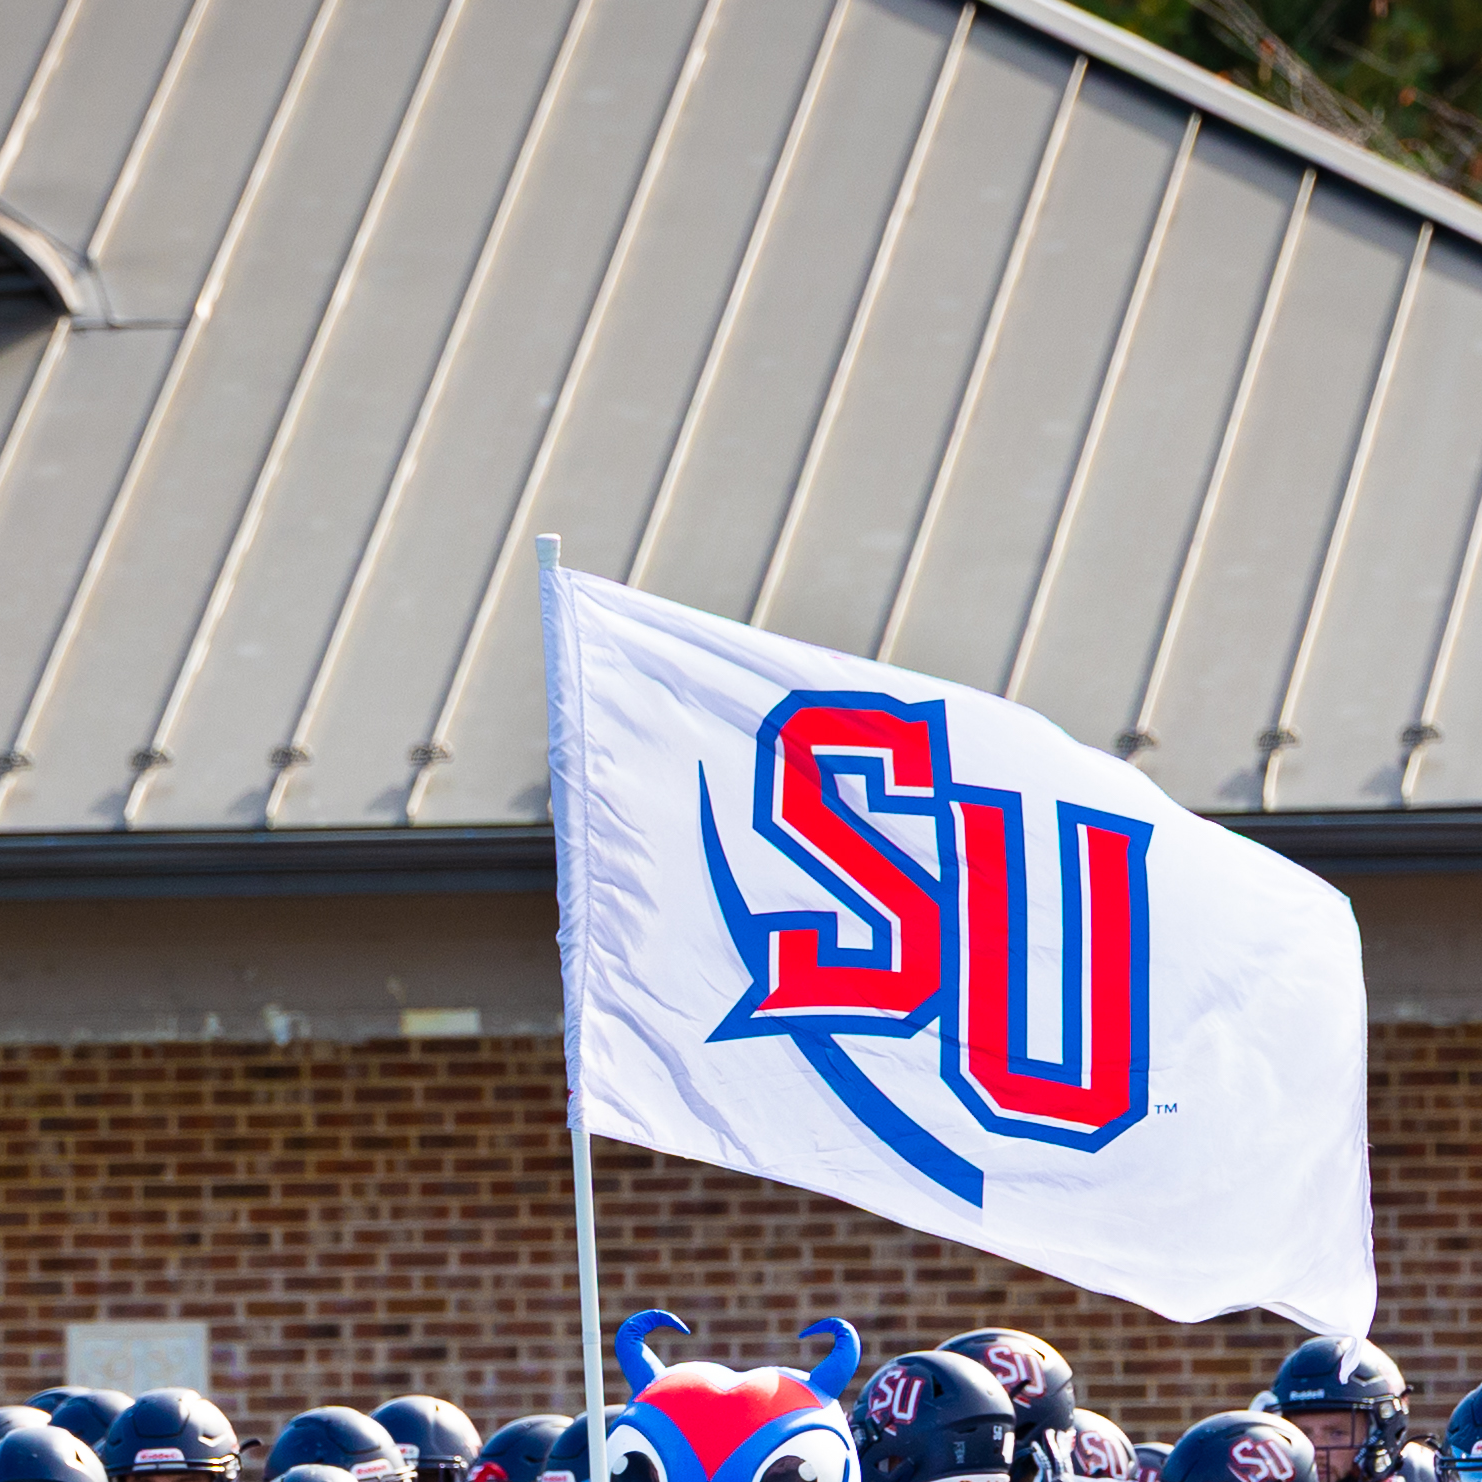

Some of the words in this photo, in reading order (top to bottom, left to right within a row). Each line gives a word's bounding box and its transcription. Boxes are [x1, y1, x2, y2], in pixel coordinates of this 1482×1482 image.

[703, 690, 1154, 1156] SU
[1154, 1102, 1179, 1115] TM
[870, 1366, 926, 1426] SU
[986, 1344, 1047, 1400] SU
